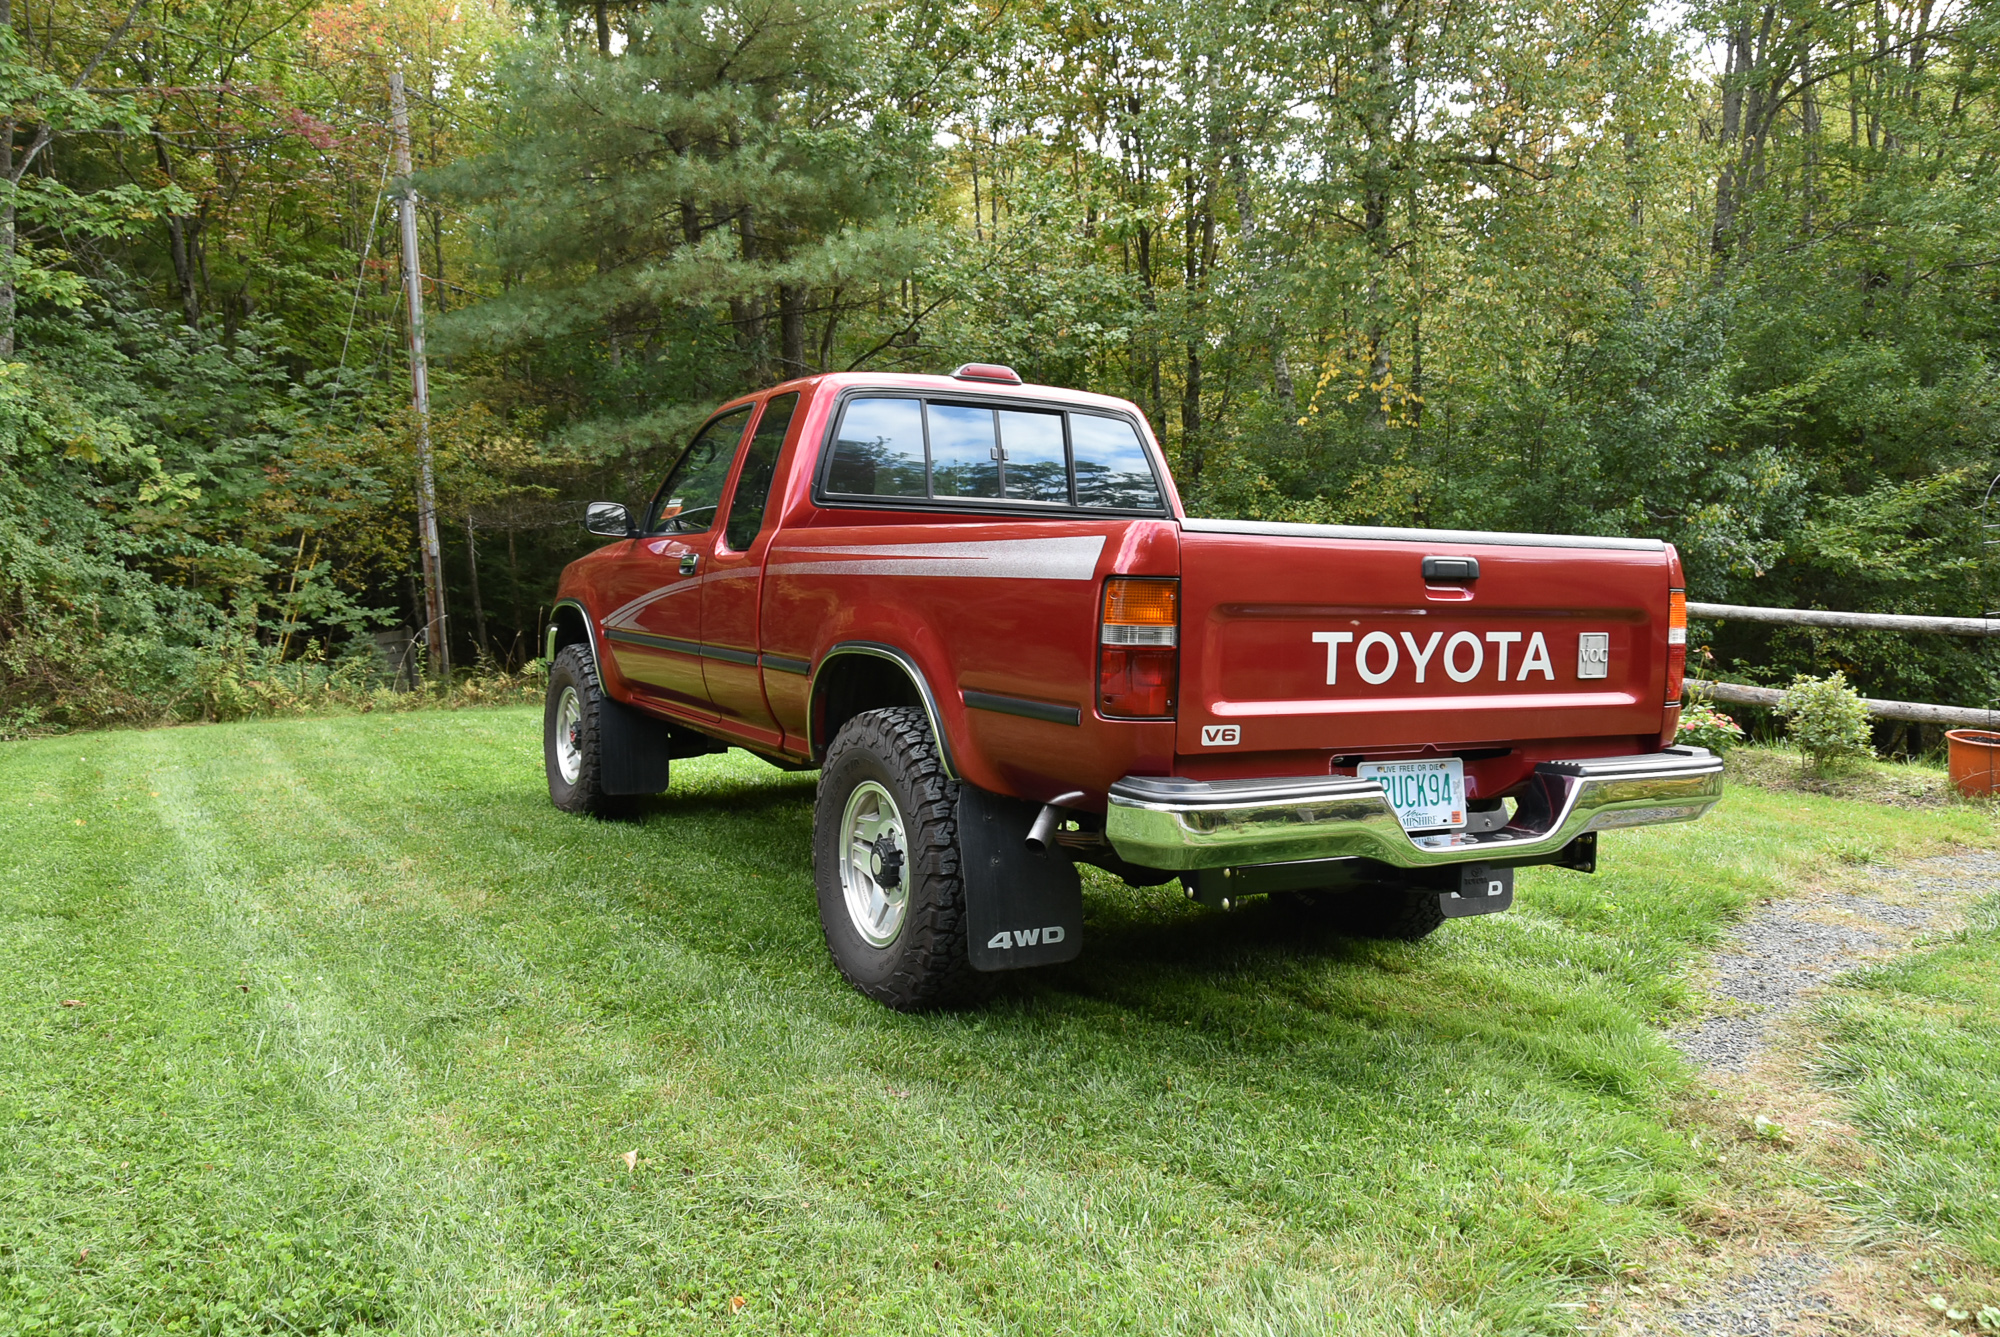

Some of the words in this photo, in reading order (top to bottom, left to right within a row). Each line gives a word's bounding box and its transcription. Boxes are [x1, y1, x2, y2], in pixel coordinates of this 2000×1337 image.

[1312, 630, 1555, 685] TOYOTA
[1205, 728, 1237, 742] V6
[1383, 765, 1396, 773] LIVE
[1400, 764, 1415, 772] FREE
[1418, 764, 1427, 772] OR
[1429, 763, 1440, 771] DIE
[1367, 773, 1452, 809] RUCK94
[1400, 809, 1428, 819] New
[1400, 815, 1438, 828] MPSHIRE
[988, 926, 1065, 949] 4WD
